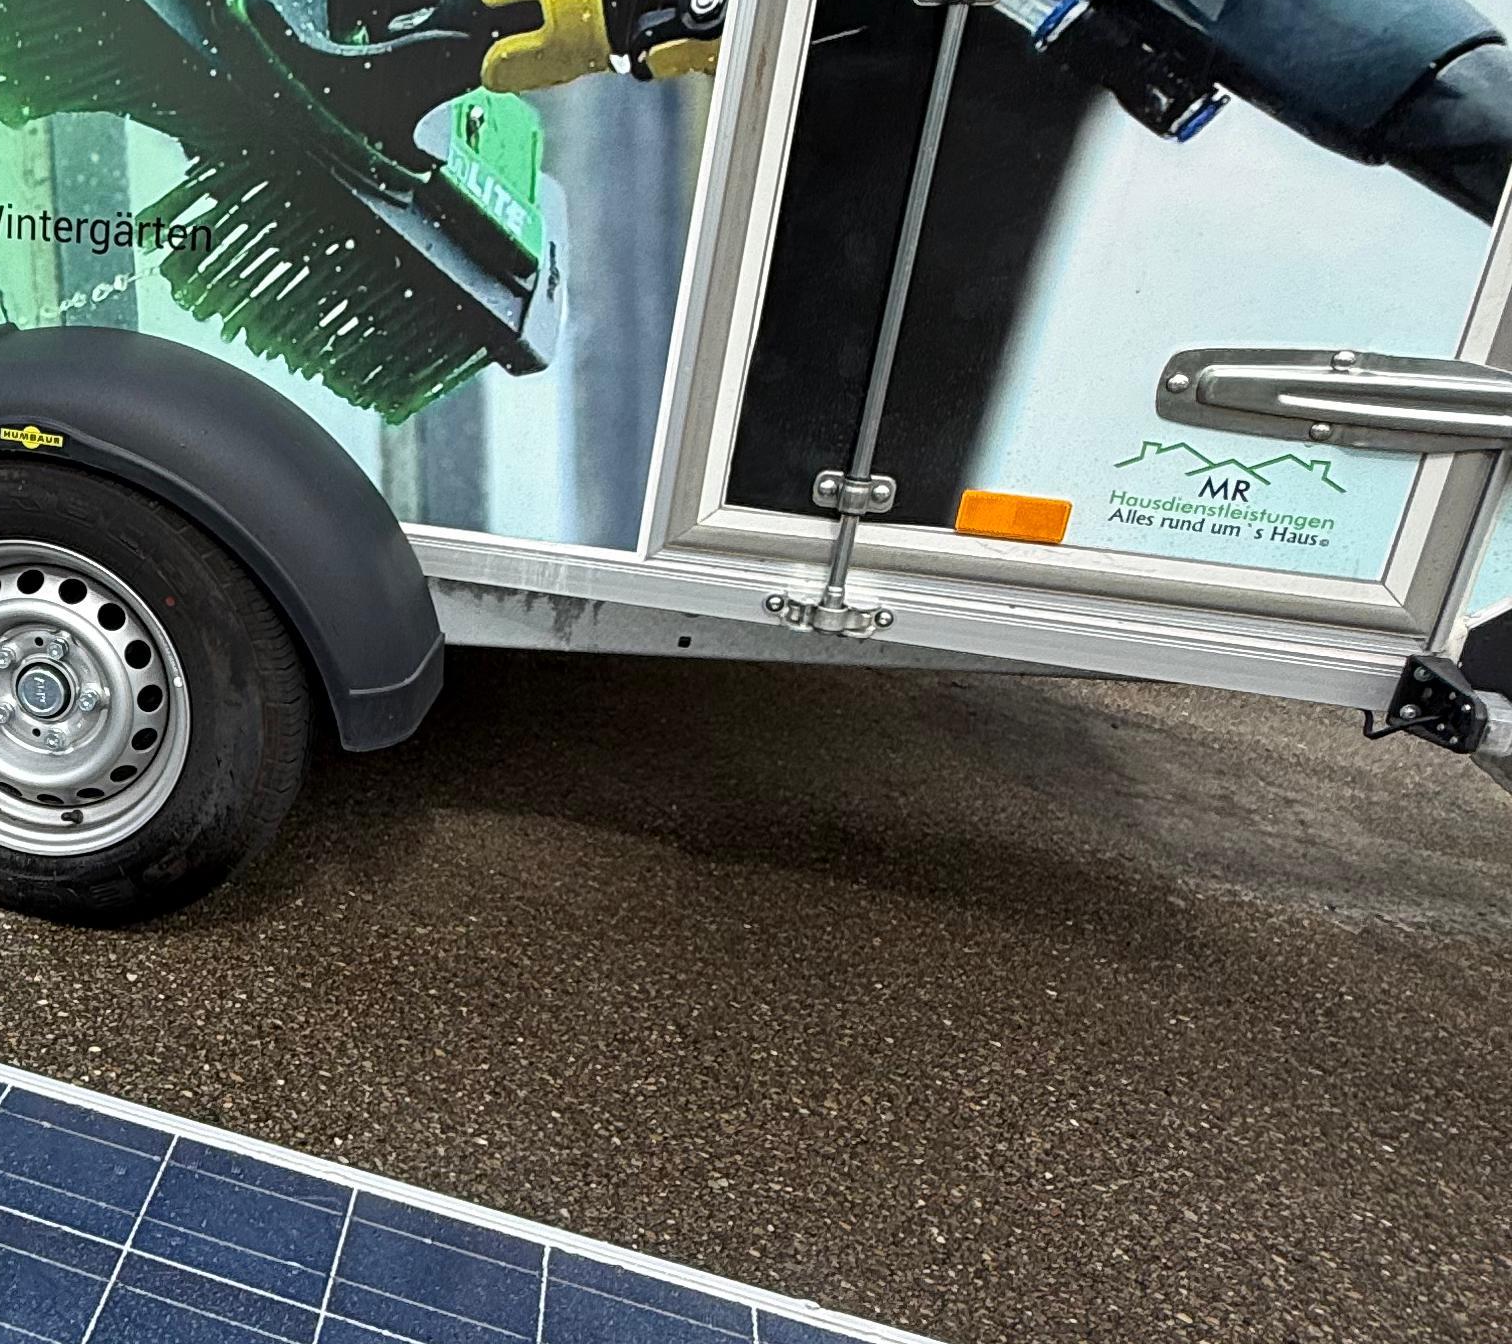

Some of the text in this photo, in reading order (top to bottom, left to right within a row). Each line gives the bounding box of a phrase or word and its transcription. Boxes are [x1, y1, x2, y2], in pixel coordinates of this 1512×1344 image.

[3, 429, 60, 445] HUMBAUR
[1198, 476, 1251, 502] MR
[1108, 507, 1154, 527] Alles
[1160, 516, 1205, 533] rund
[1109, 489, 1335, 530] Hausdienstleistungen
